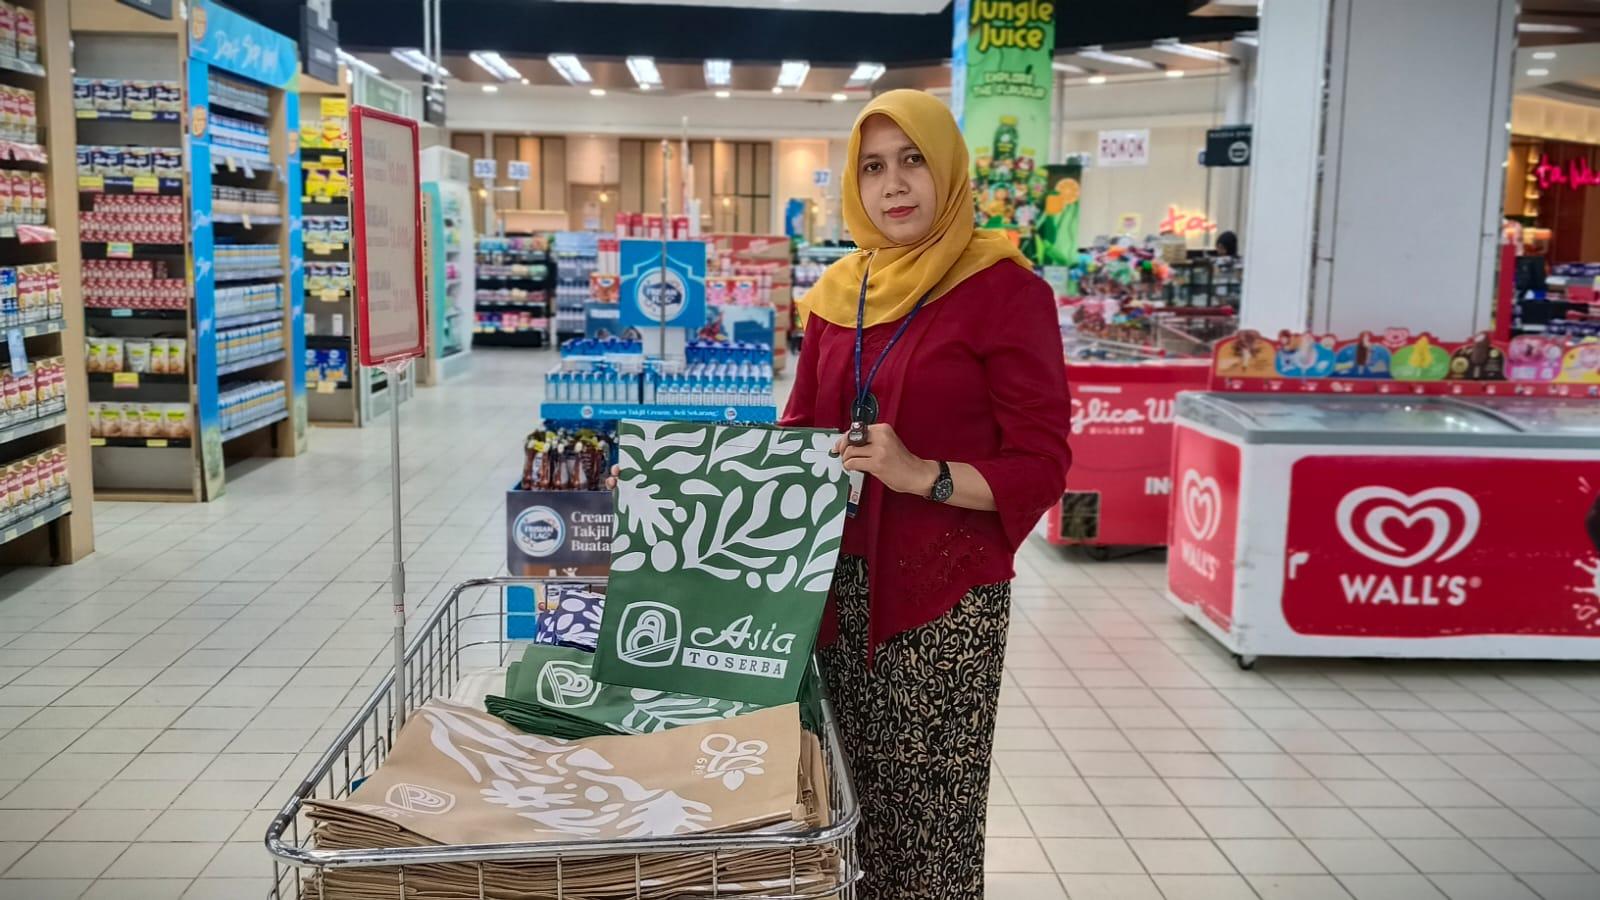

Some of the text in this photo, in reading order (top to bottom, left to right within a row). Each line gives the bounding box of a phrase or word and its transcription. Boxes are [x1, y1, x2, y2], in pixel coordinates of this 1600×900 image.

[971, 0, 1053, 27] Jungle
[979, 22, 1042, 51] Juice
[1101, 138, 1145, 158] ROKOK
[571, 525, 609, 540] Takjil
[571, 540, 611, 551] Buata
[1340, 574, 1466, 605] WALL'S
[690, 614, 796, 654] Asia
[689, 652, 783, 675] TOSERBA
